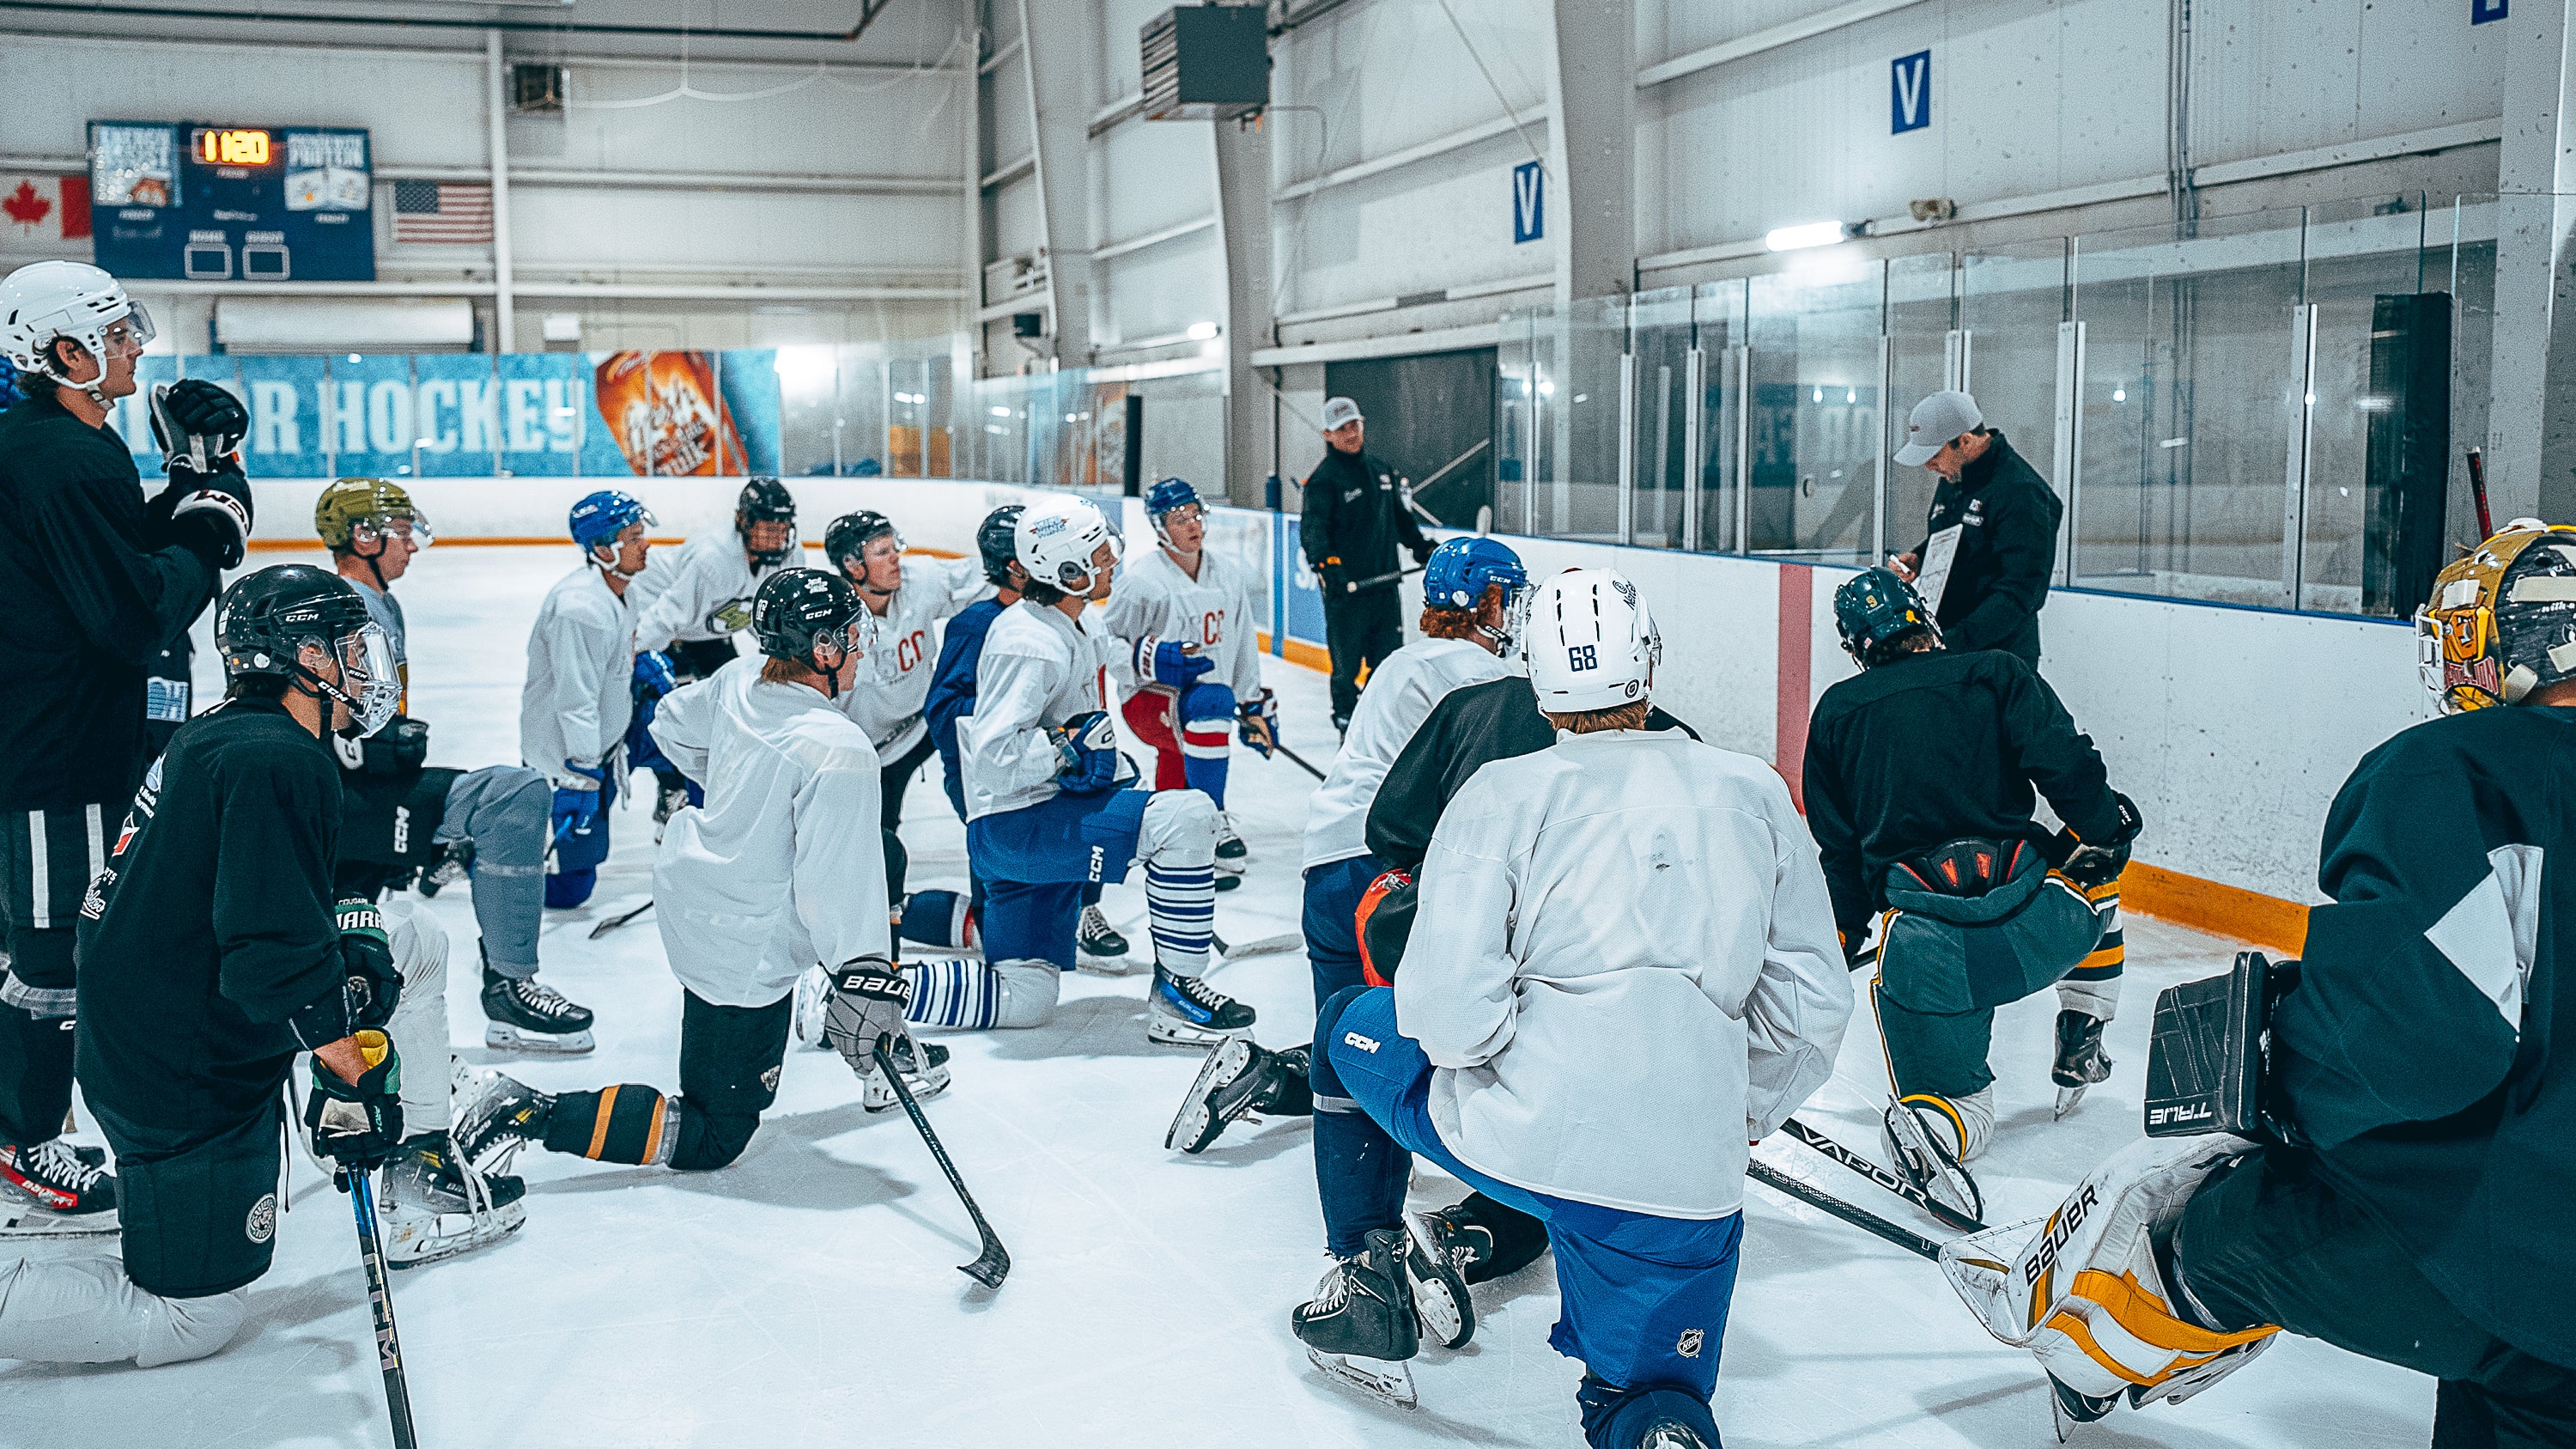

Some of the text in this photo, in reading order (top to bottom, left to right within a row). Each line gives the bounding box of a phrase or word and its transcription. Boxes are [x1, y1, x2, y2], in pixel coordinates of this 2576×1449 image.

[1894, 58, 1925, 125] V
[1516, 167, 1540, 235] V
[319, 379, 586, 454] HOCKEY
[1489, 575, 1512, 584] CCM
[285, 613, 319, 623] CCM
[805, 608, 833, 620] CCM
[1485, 624, 1507, 639] CCM
[1568, 644, 1599, 673] 68
[318, 680, 349, 702] CCM
[2118, 805, 2132, 822] CCM
[393, 805, 410, 854] CCM
[1089, 845, 1104, 882] CCM
[1345, 1032, 1381, 1054] CCM
[2150, 1101, 2212, 1126] TRUE
[1801, 1125, 1929, 1207] VAPOR
[364, 1253, 399, 1372] CCM
